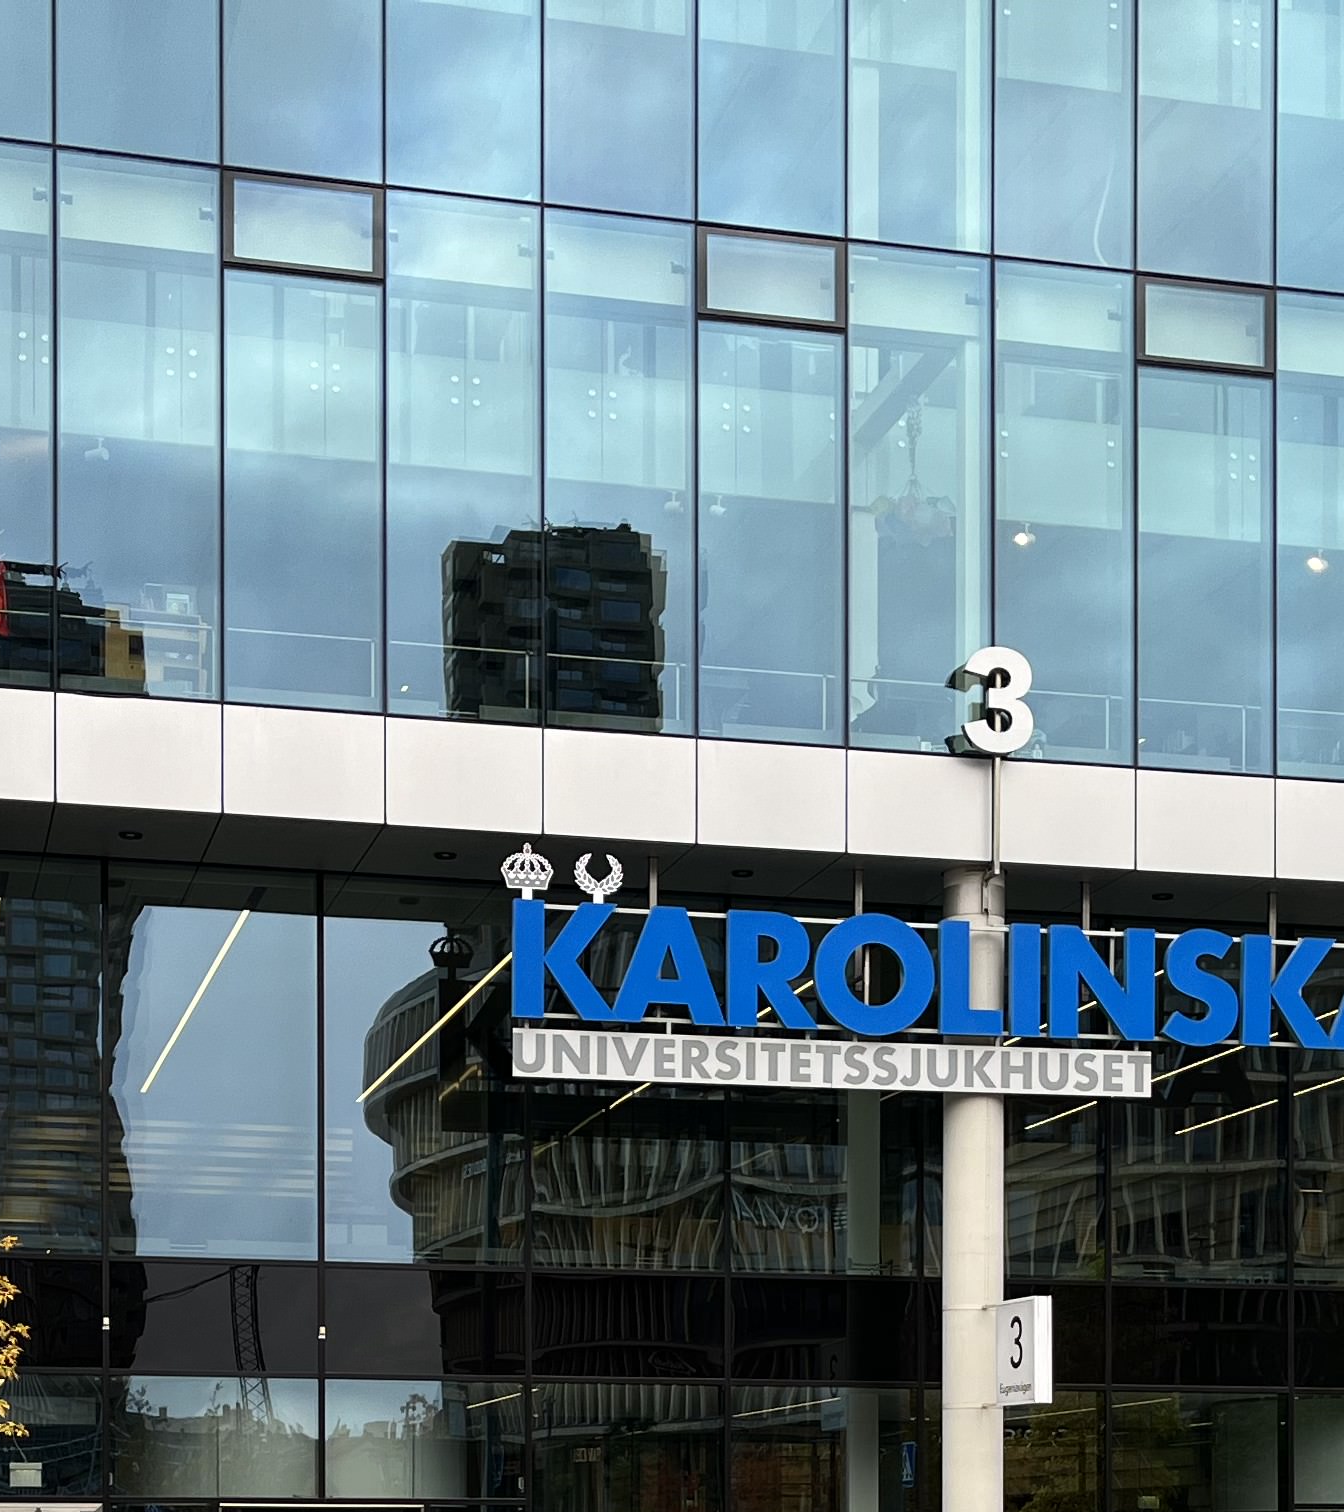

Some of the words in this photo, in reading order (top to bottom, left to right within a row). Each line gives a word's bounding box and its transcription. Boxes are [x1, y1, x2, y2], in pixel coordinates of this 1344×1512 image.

[962, 646, 1035, 755] 3
[513, 1034, 1150, 1096] UNIVERSITETSSJUKHUSET
[1010, 1316, 1023, 1369] 3
